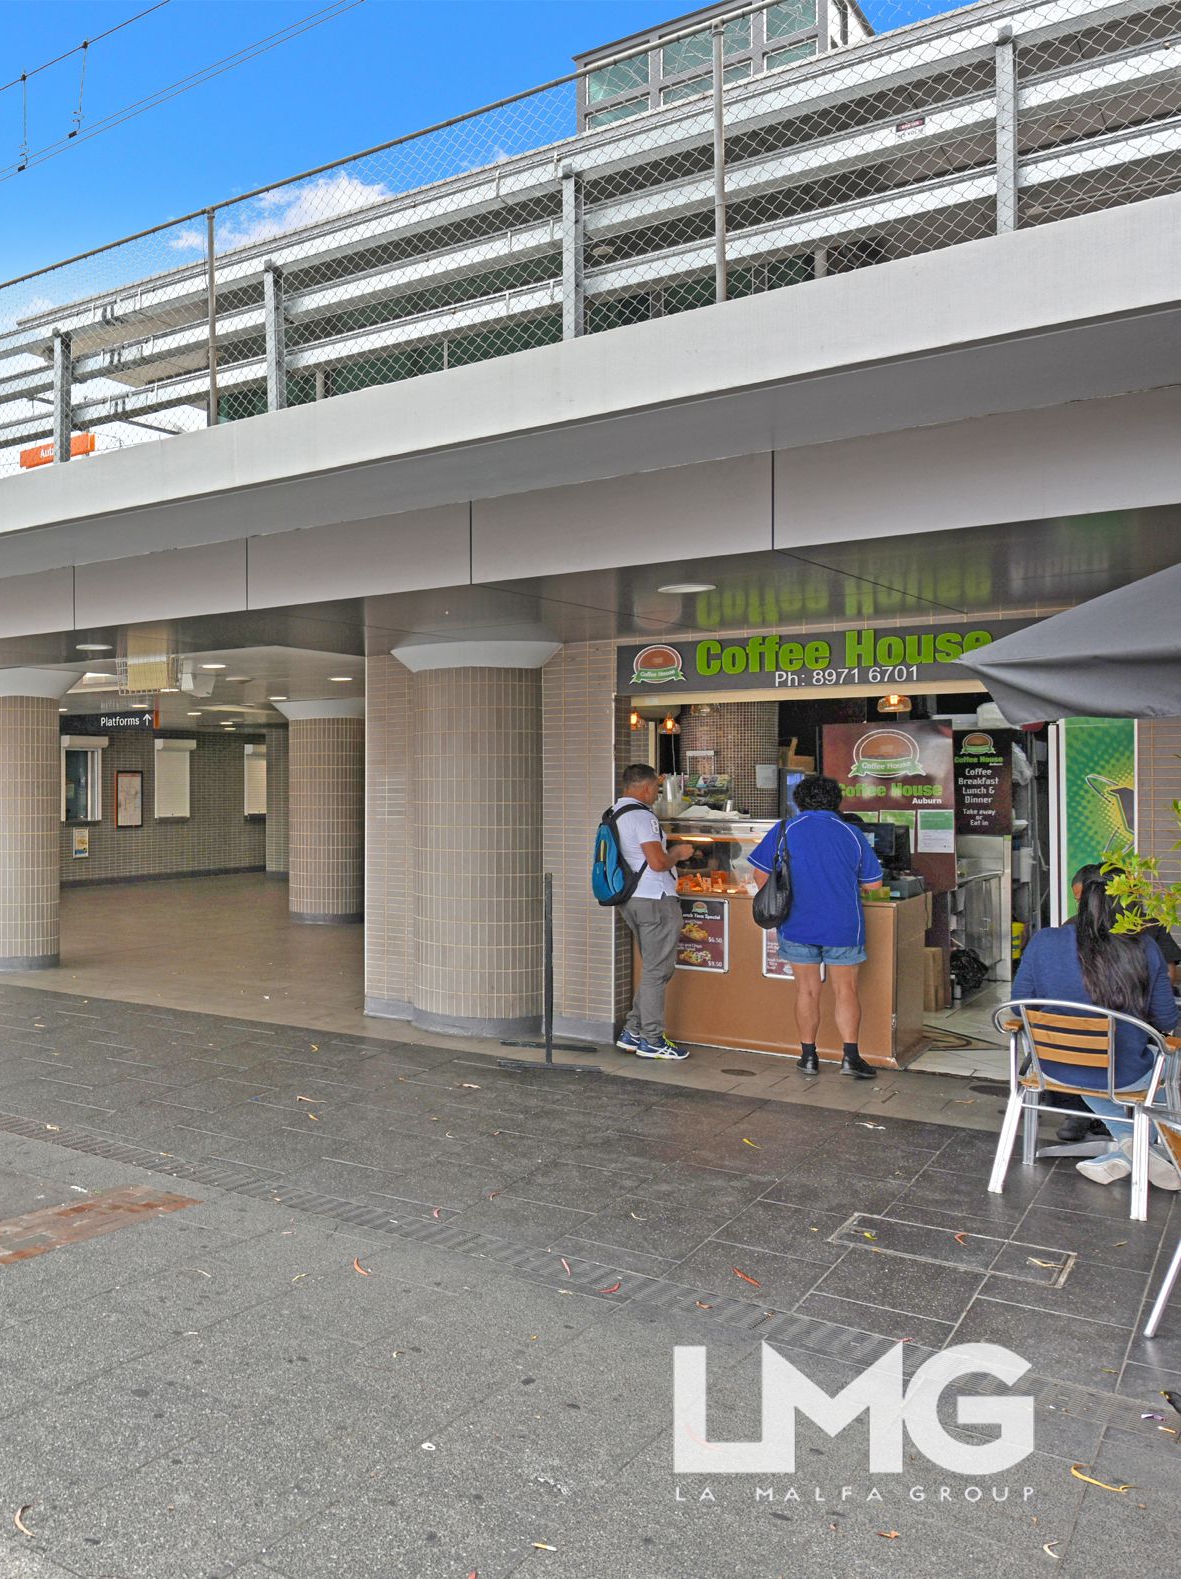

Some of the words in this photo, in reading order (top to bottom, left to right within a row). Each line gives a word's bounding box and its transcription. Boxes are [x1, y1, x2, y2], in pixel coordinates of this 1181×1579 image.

[40, 446, 55, 459] Aub
[695, 635, 831, 676] Coffee
[844, 629, 992, 668] House
[775, 671, 806, 687] Ph:
[812, 667, 859, 685] 8971
[868, 664, 918, 683] 6701
[100, 716, 140, 727] Platforms
[861, 762, 886, 770] Coffee
[965, 768, 992, 776] Coffee
[958, 777, 999, 785] Breakfast
[891, 783, 943, 796] House
[962, 786, 987, 794] Lunch
[988, 786, 995, 794] &
[965, 796, 993, 804] Dinner
